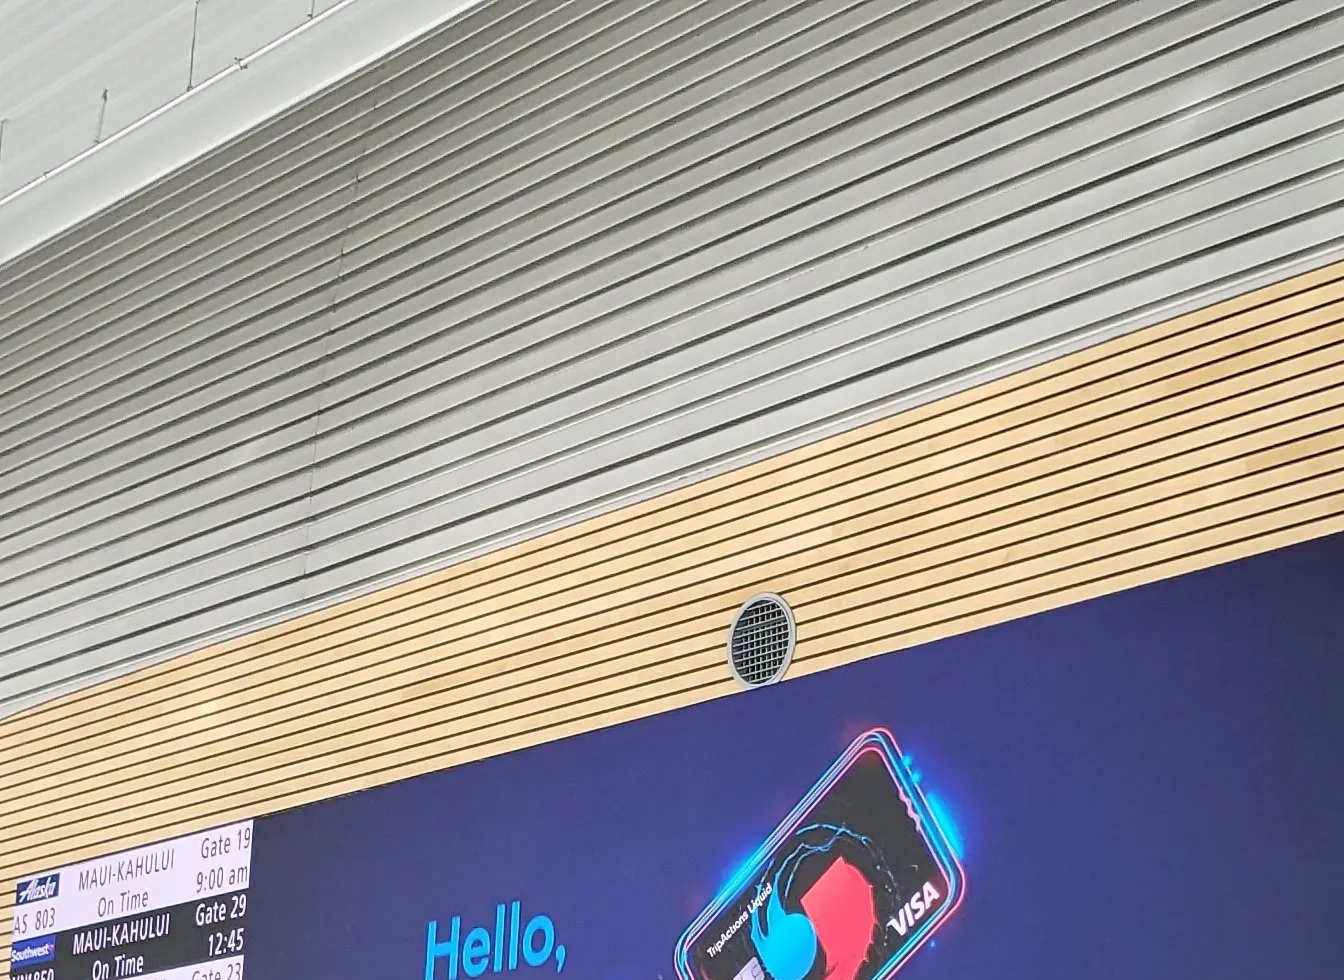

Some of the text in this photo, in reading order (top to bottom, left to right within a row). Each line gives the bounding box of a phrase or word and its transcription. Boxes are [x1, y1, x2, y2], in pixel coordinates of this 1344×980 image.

[200, 829, 251, 859] Gate 19
[78, 848, 175, 892] MAUI-KAHULUI
[197, 867, 248, 893] 9:00 am
[19, 877, 56, 904] Alaska
[97, 890, 149, 917] On Time
[13, 907, 56, 935] AS 803
[195, 894, 246, 926] Gate 29
[707, 883, 773, 958] TripActions Liquid
[887, 882, 940, 936] VISA
[72, 913, 170, 954] MAUI-KAHULUI
[207, 928, 244, 956] 12:45
[11, 942, 51, 962] Southwest
[114, 956, 144, 977] Time
